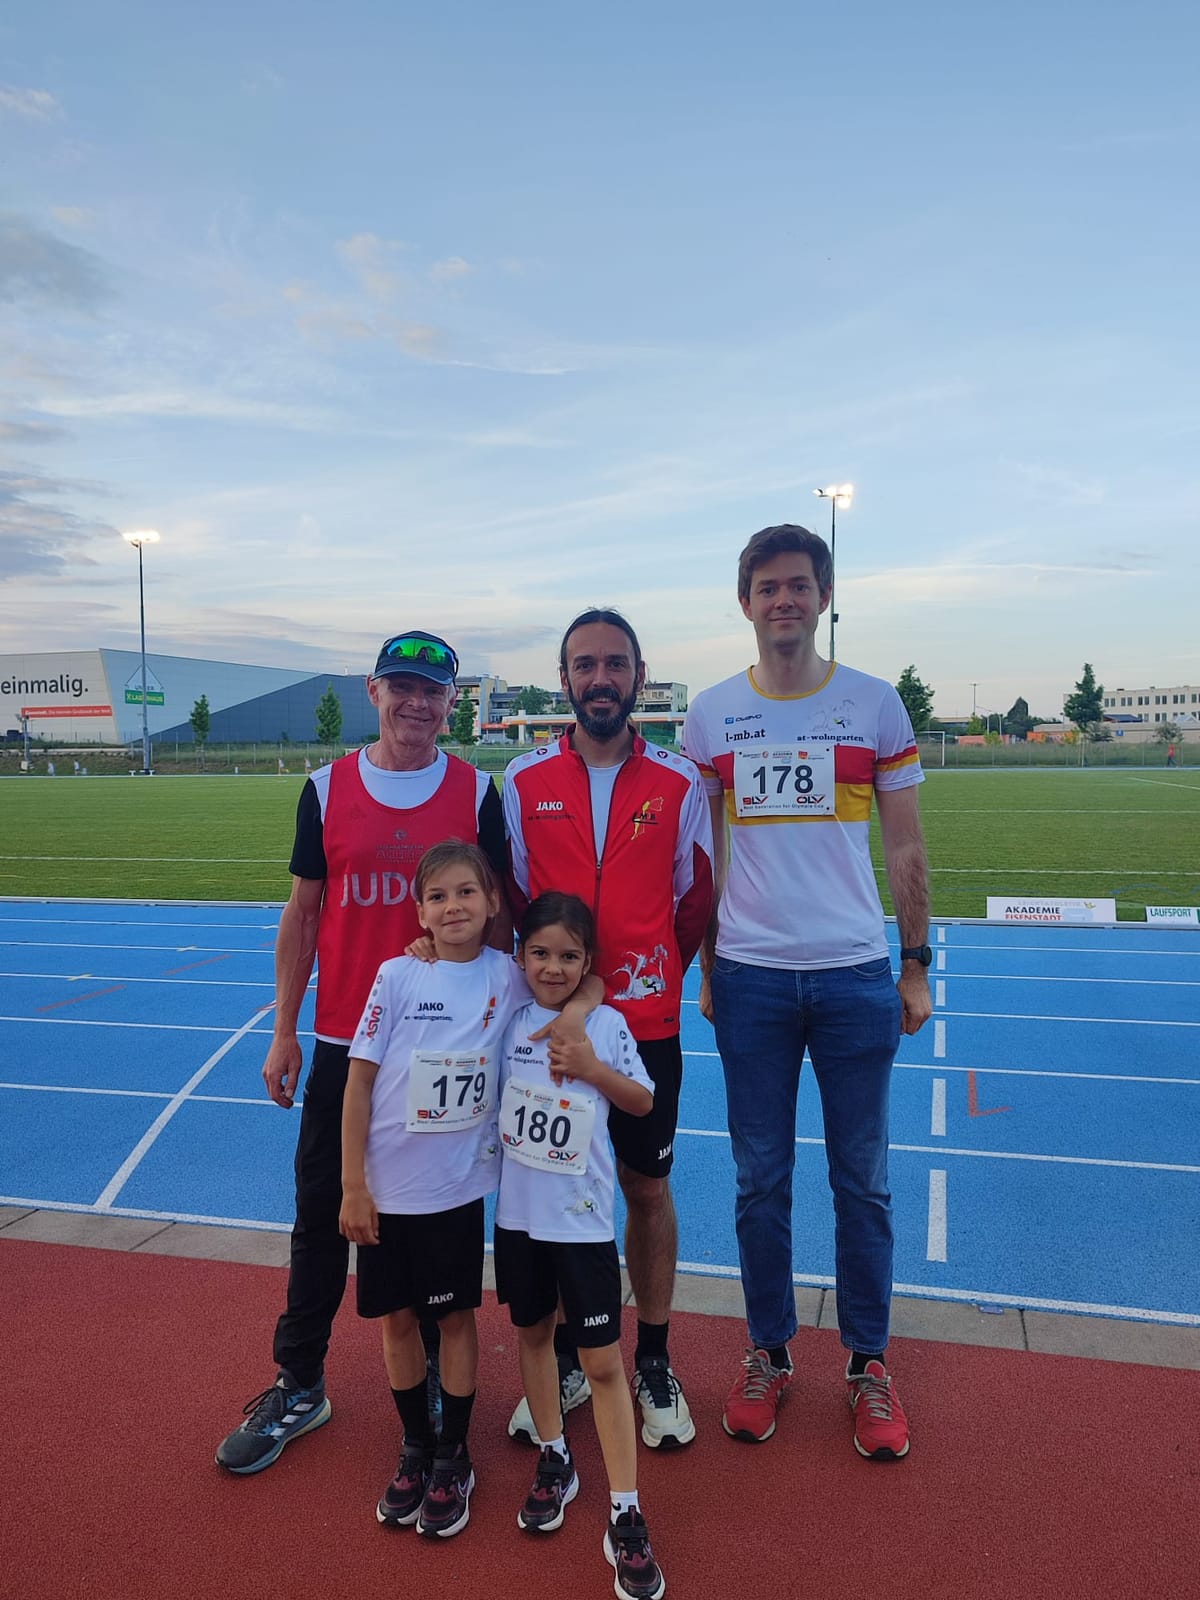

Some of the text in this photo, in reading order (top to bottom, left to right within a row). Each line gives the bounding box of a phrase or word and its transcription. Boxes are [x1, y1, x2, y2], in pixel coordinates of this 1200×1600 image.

[1, 674, 89, 697] einmalig.
[753, 765, 813, 794] 178
[536, 801, 563, 811] JAKO
[1005, 906, 1060, 914] AKADEMIE
[1150, 908, 1191, 917] LAUFSPORT
[417, 1002, 444, 1011] JAKO
[433, 1072, 486, 1107] 179
[514, 1105, 571, 1148] 180
[427, 1292, 454, 1305] JAKO
[583, 1314, 609, 1327] JAKO
